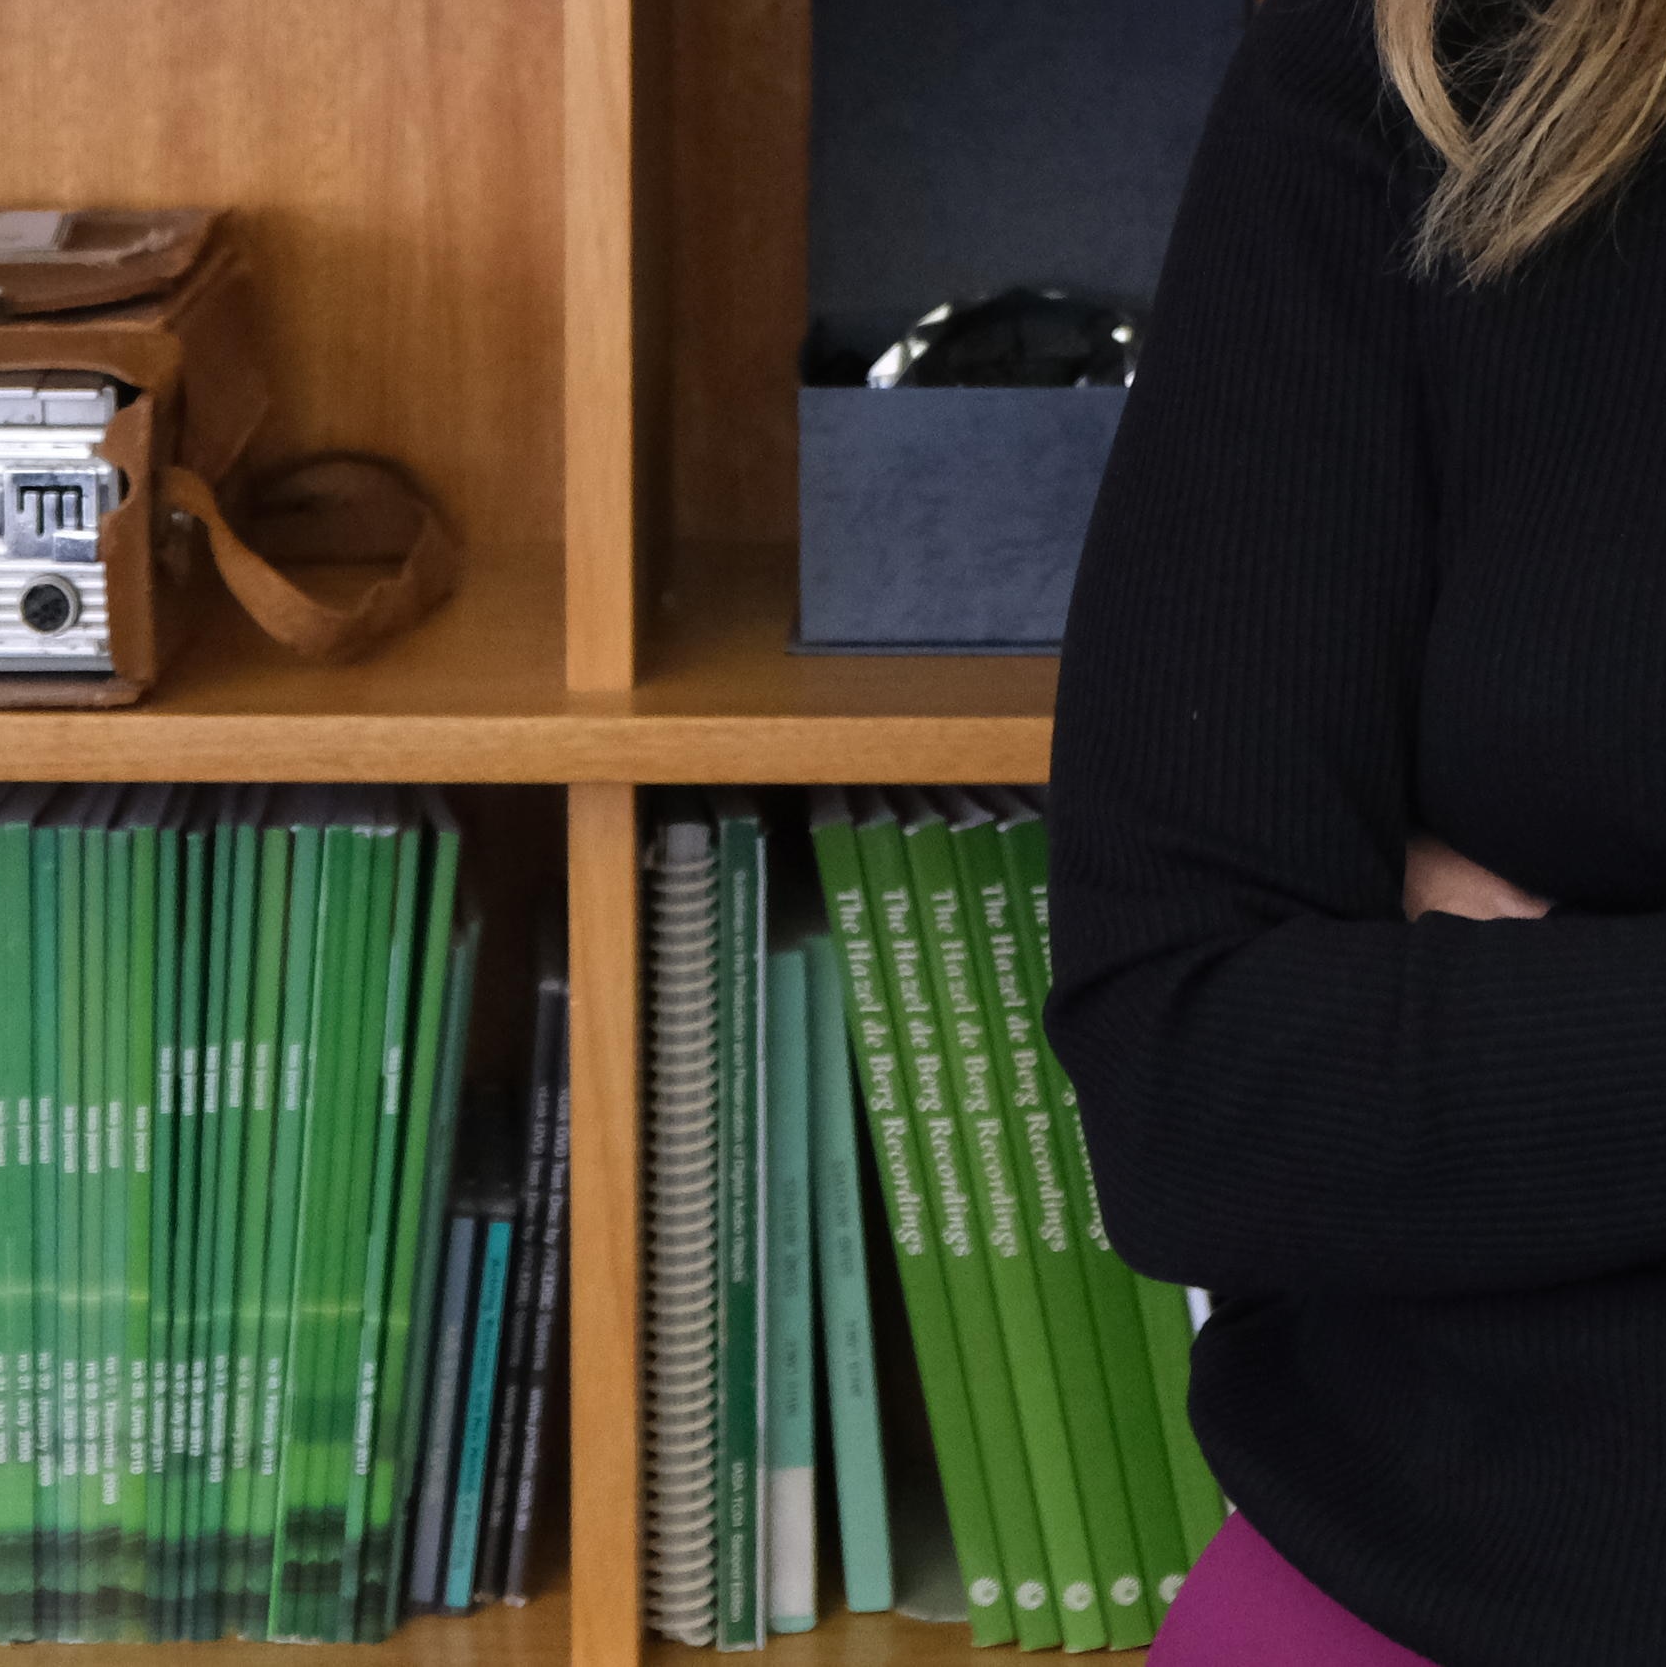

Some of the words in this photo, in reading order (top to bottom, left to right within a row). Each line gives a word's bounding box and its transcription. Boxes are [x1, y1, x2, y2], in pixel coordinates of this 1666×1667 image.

[835, 888, 863, 934] The
[882, 889, 910, 933] The
[930, 889, 958, 933] The
[981, 883, 1008, 927] The
[844, 939, 883, 1013] Hazel
[891, 939, 932, 1013] Hazel
[939, 940, 978, 1013] Hazel
[990, 934, 1027, 1007] Hazel
[732, 975, 747, 1040] Production
[1005, 1014, 1031, 1042] de
[859, 1019, 888, 1048] de
[907, 1020, 935, 1048] de
[956, 1021, 983, 1048] de
[868, 1053, 898, 1112] Berg
[915, 1053, 944, 1112] Berg
[963, 1055, 991, 1112] Berg
[1013, 1049, 1040, 1107] Berg
[881, 1116, 926, 1256] Recordings
[927, 1117, 973, 1257] Recordings
[975, 1118, 1020, 1257] Recordings
[1025, 1112, 1068, 1252] Recordings
[17, 1354, 30, 1372] no
[63, 1361, 75, 1379] no
[85, 1362, 98, 1379] no
[104, 1356, 117, 1375] no
[131, 1361, 144, 1379] no
[16, 1399, 30, 1427] July
[63, 1406, 77, 1440] June
[85, 1406, 99, 1440] June
[103, 1401, 118, 1468] December
[130, 1405, 144, 1439] June
[129, 1442, 143, 1475] 2010
